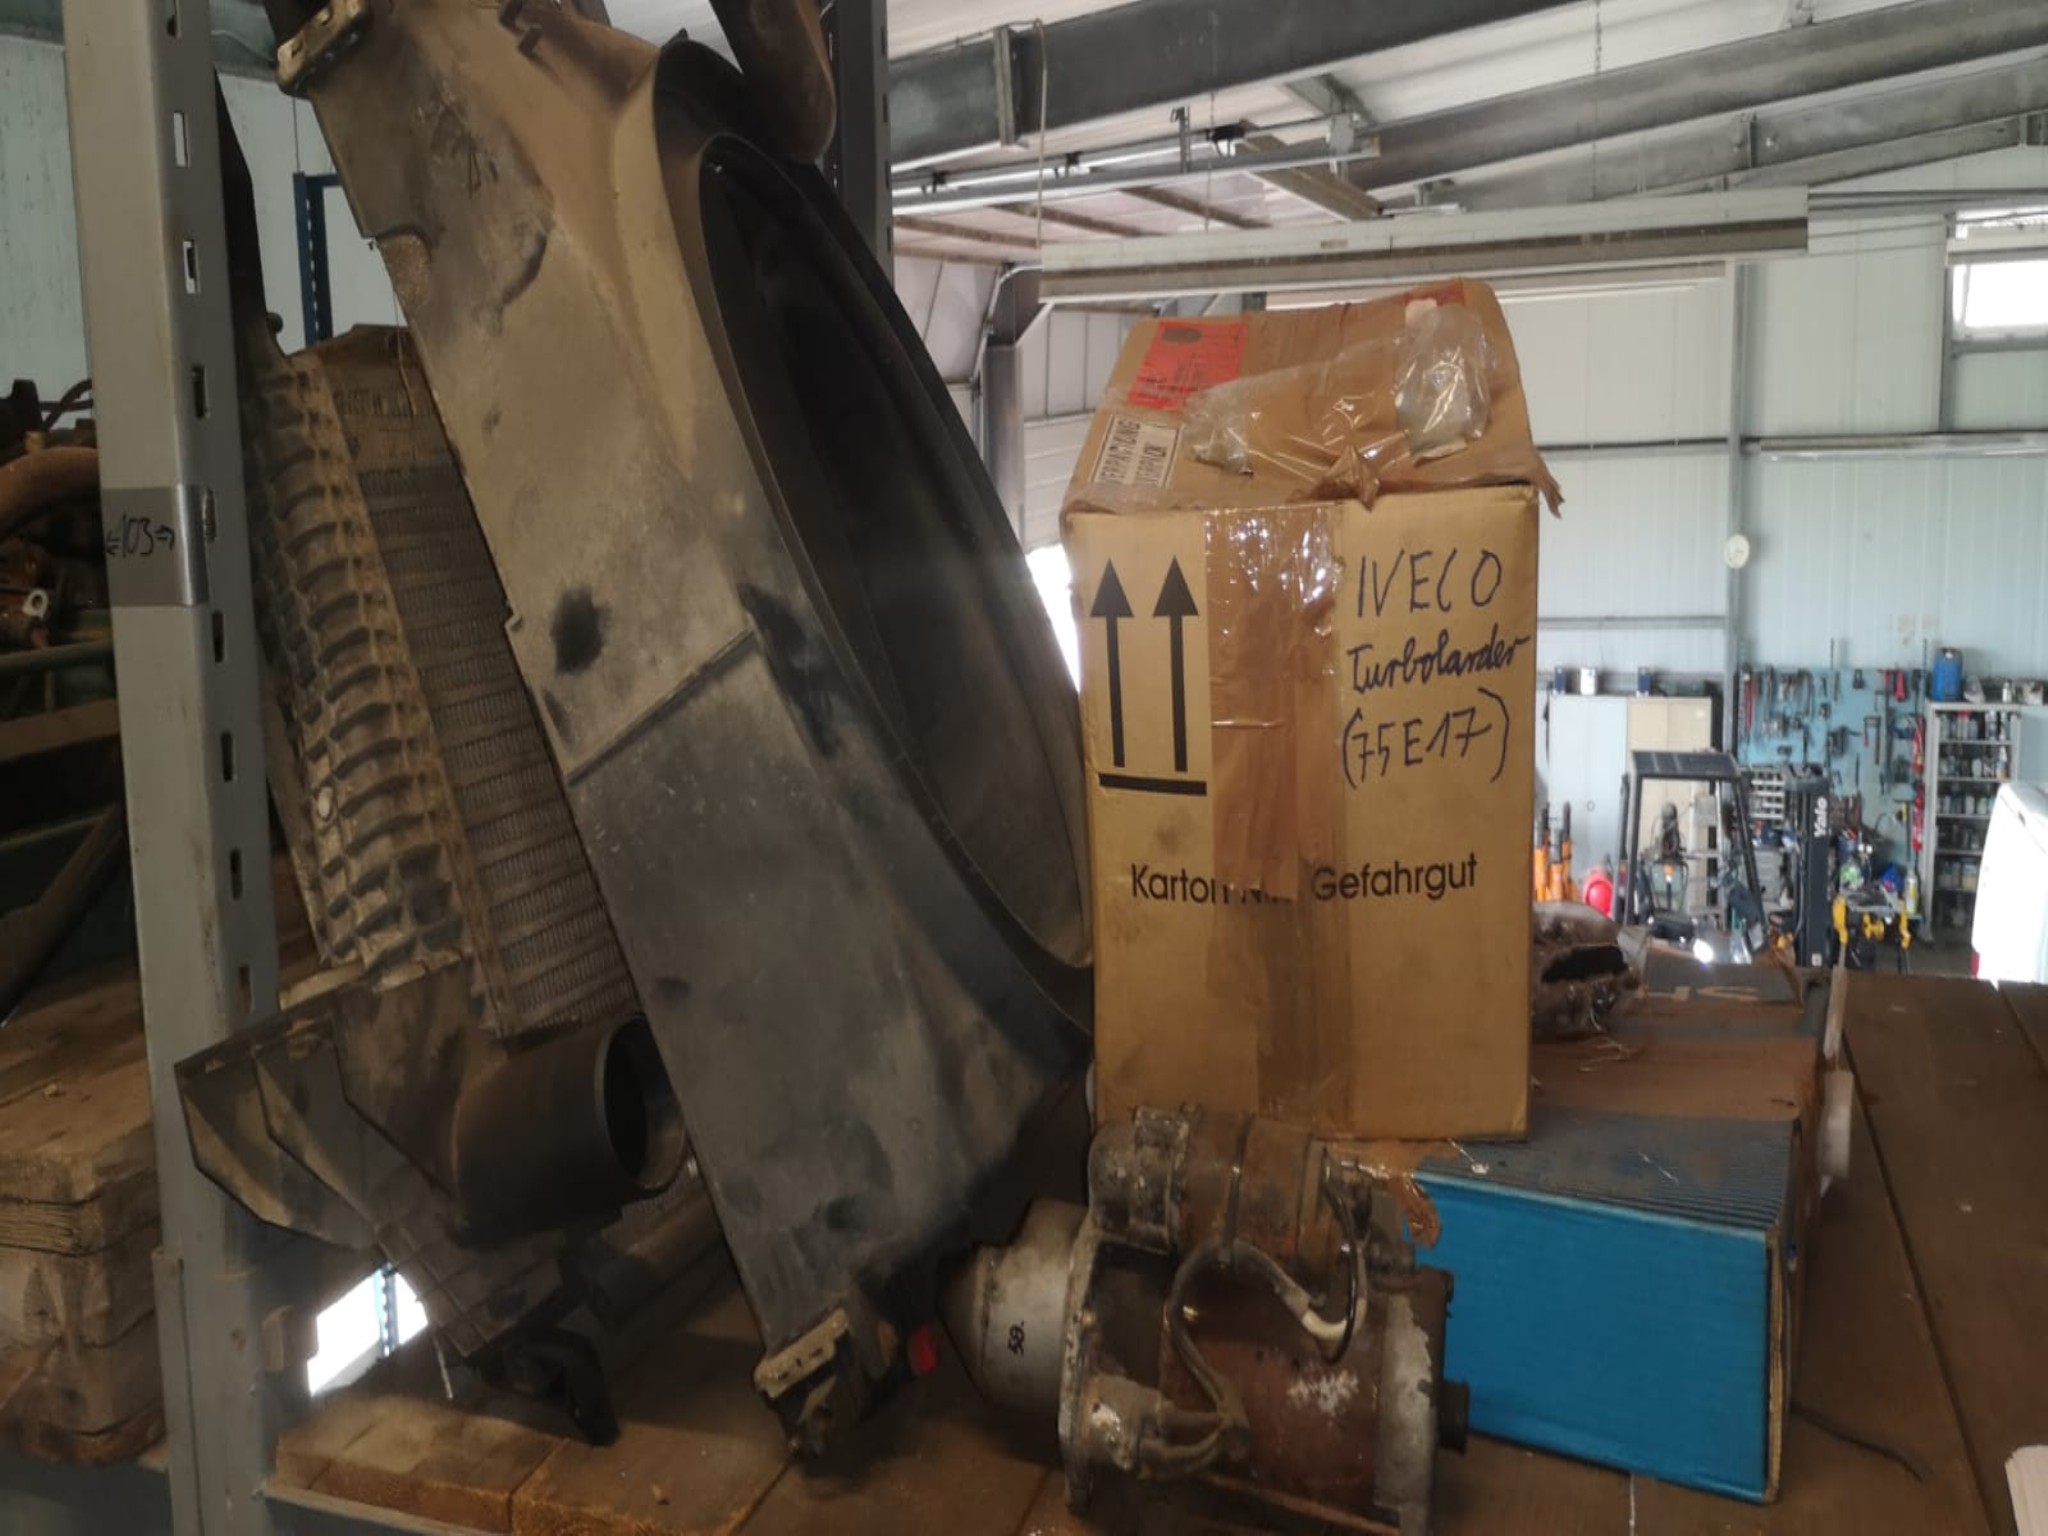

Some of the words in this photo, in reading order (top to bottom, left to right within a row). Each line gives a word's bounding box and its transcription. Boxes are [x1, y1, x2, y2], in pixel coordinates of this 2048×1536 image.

[1357, 548, 1503, 618] IVECO
[1342, 685, 1510, 791] (75E17)
[1311, 853, 1478, 901] Gefahrgut
